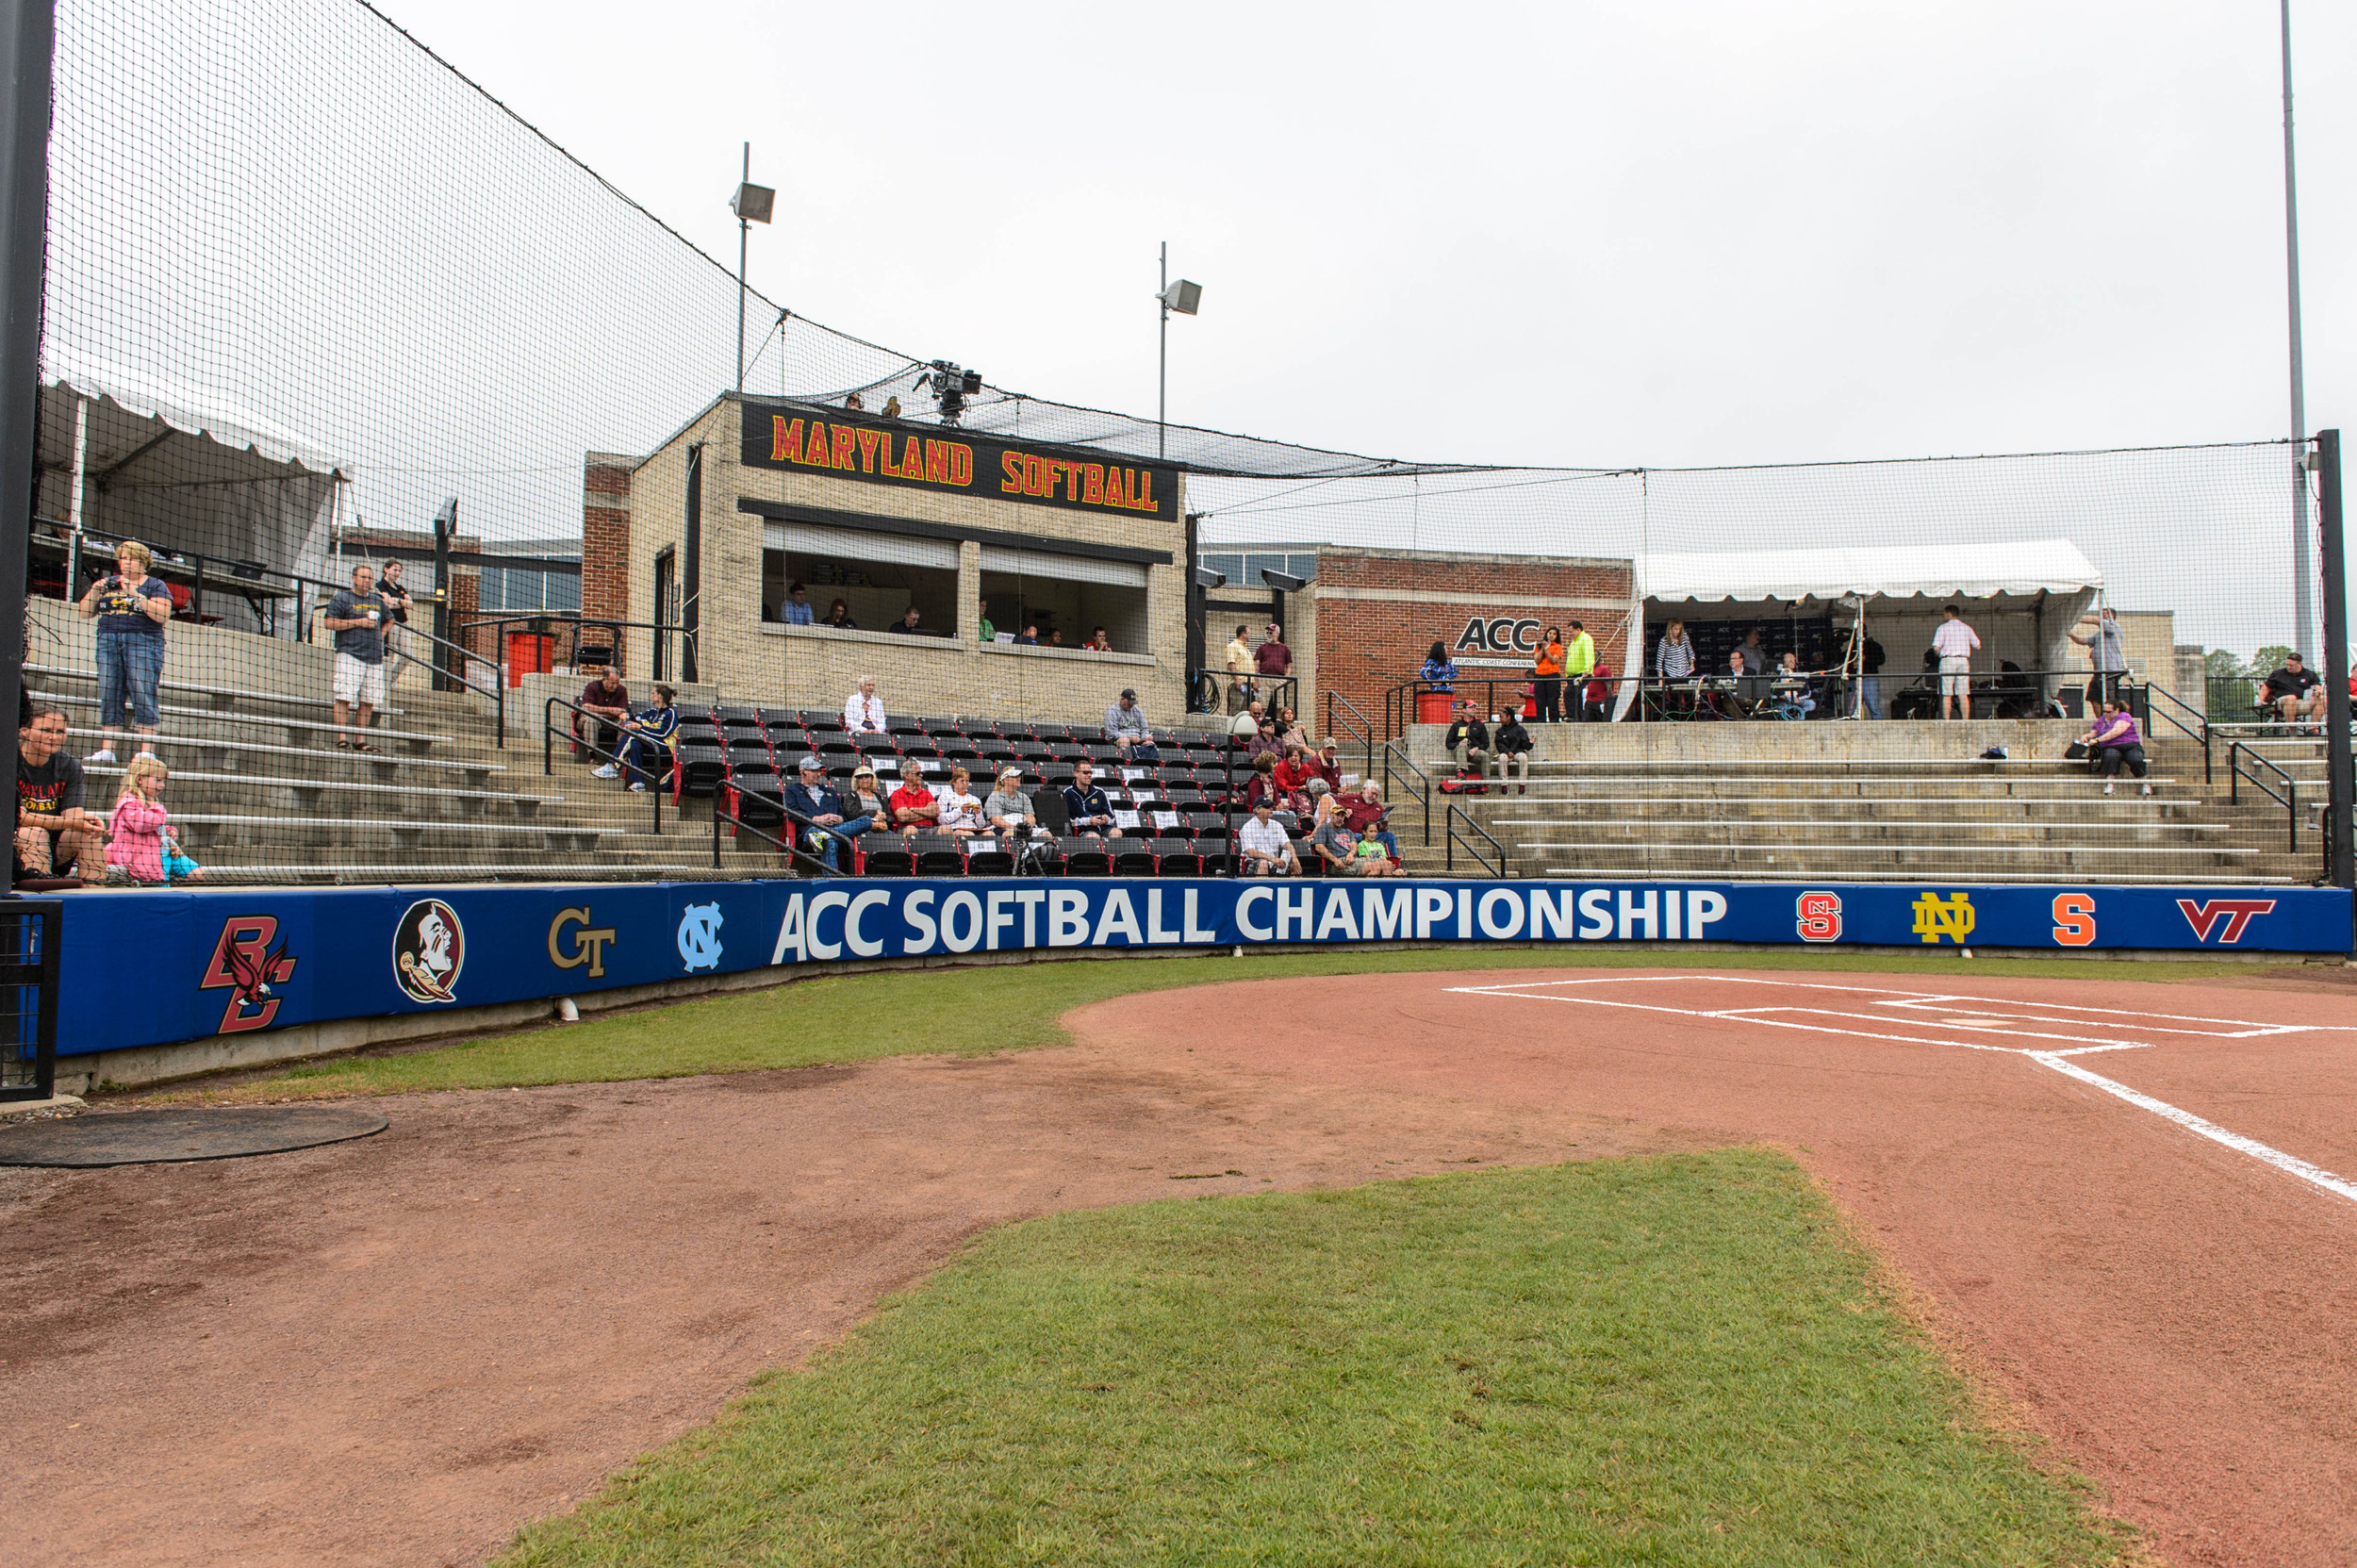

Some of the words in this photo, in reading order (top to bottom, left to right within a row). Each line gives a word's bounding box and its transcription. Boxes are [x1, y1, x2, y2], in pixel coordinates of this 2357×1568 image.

[771, 415, 972, 487] MARYLAND
[1001, 450, 1158, 512] SOFTBALL
[1454, 617, 1541, 653] ACC
[548, 905, 616, 978] GT
[770, 889, 891, 965] ACC
[902, 888, 1216, 953] SOFTBALL
[1234, 886, 1728, 941] CHAMPIONSHIP
[2052, 893, 2096, 946] S
[2175, 900, 2277, 943] VT
